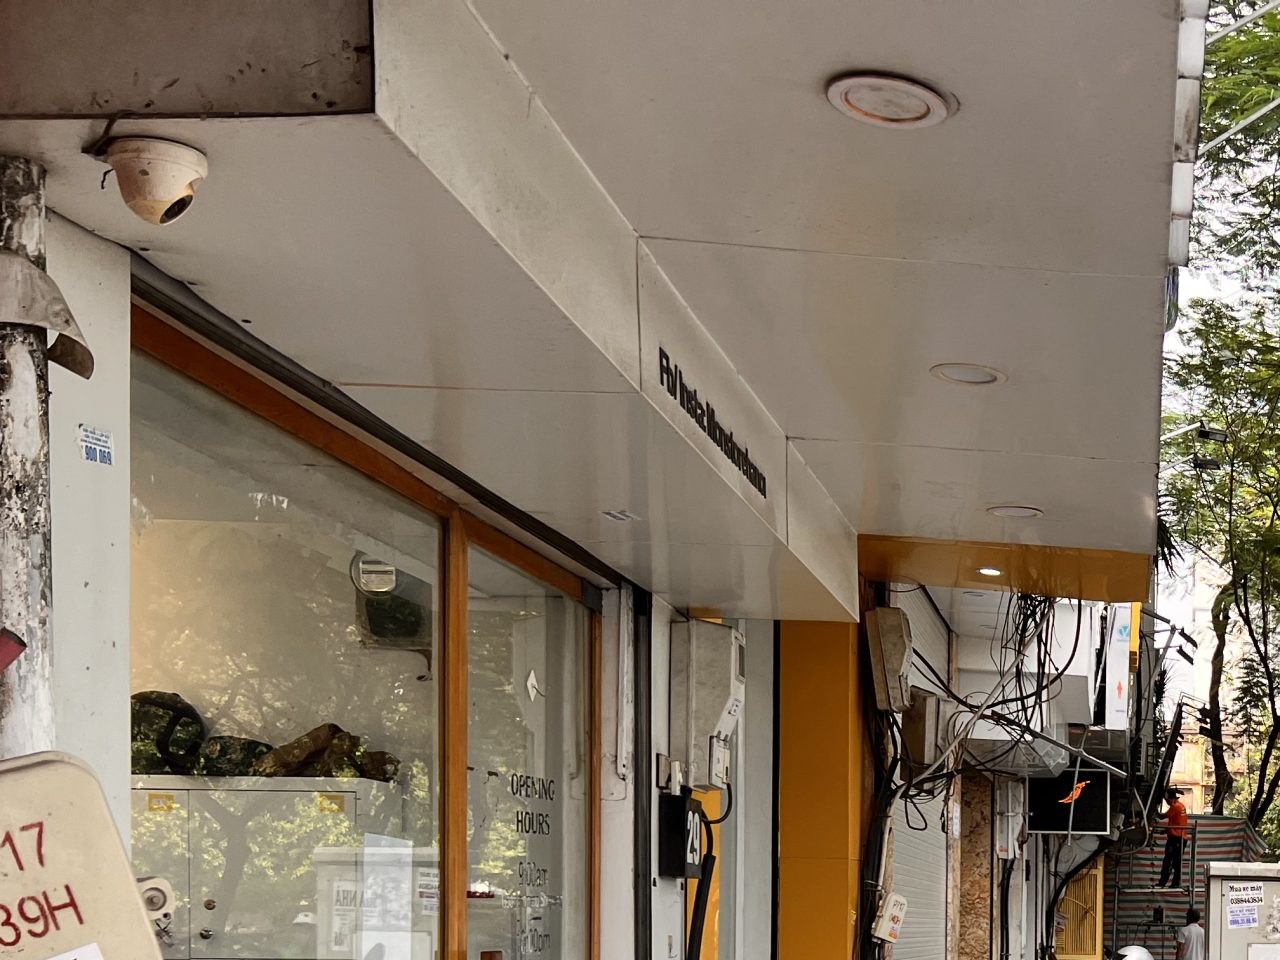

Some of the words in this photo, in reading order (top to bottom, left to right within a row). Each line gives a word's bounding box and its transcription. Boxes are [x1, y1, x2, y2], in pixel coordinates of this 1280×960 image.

[511, 773, 555, 801] OPENING
[516, 811, 550, 835] HOURS
[687, 811, 700, 865] 29
